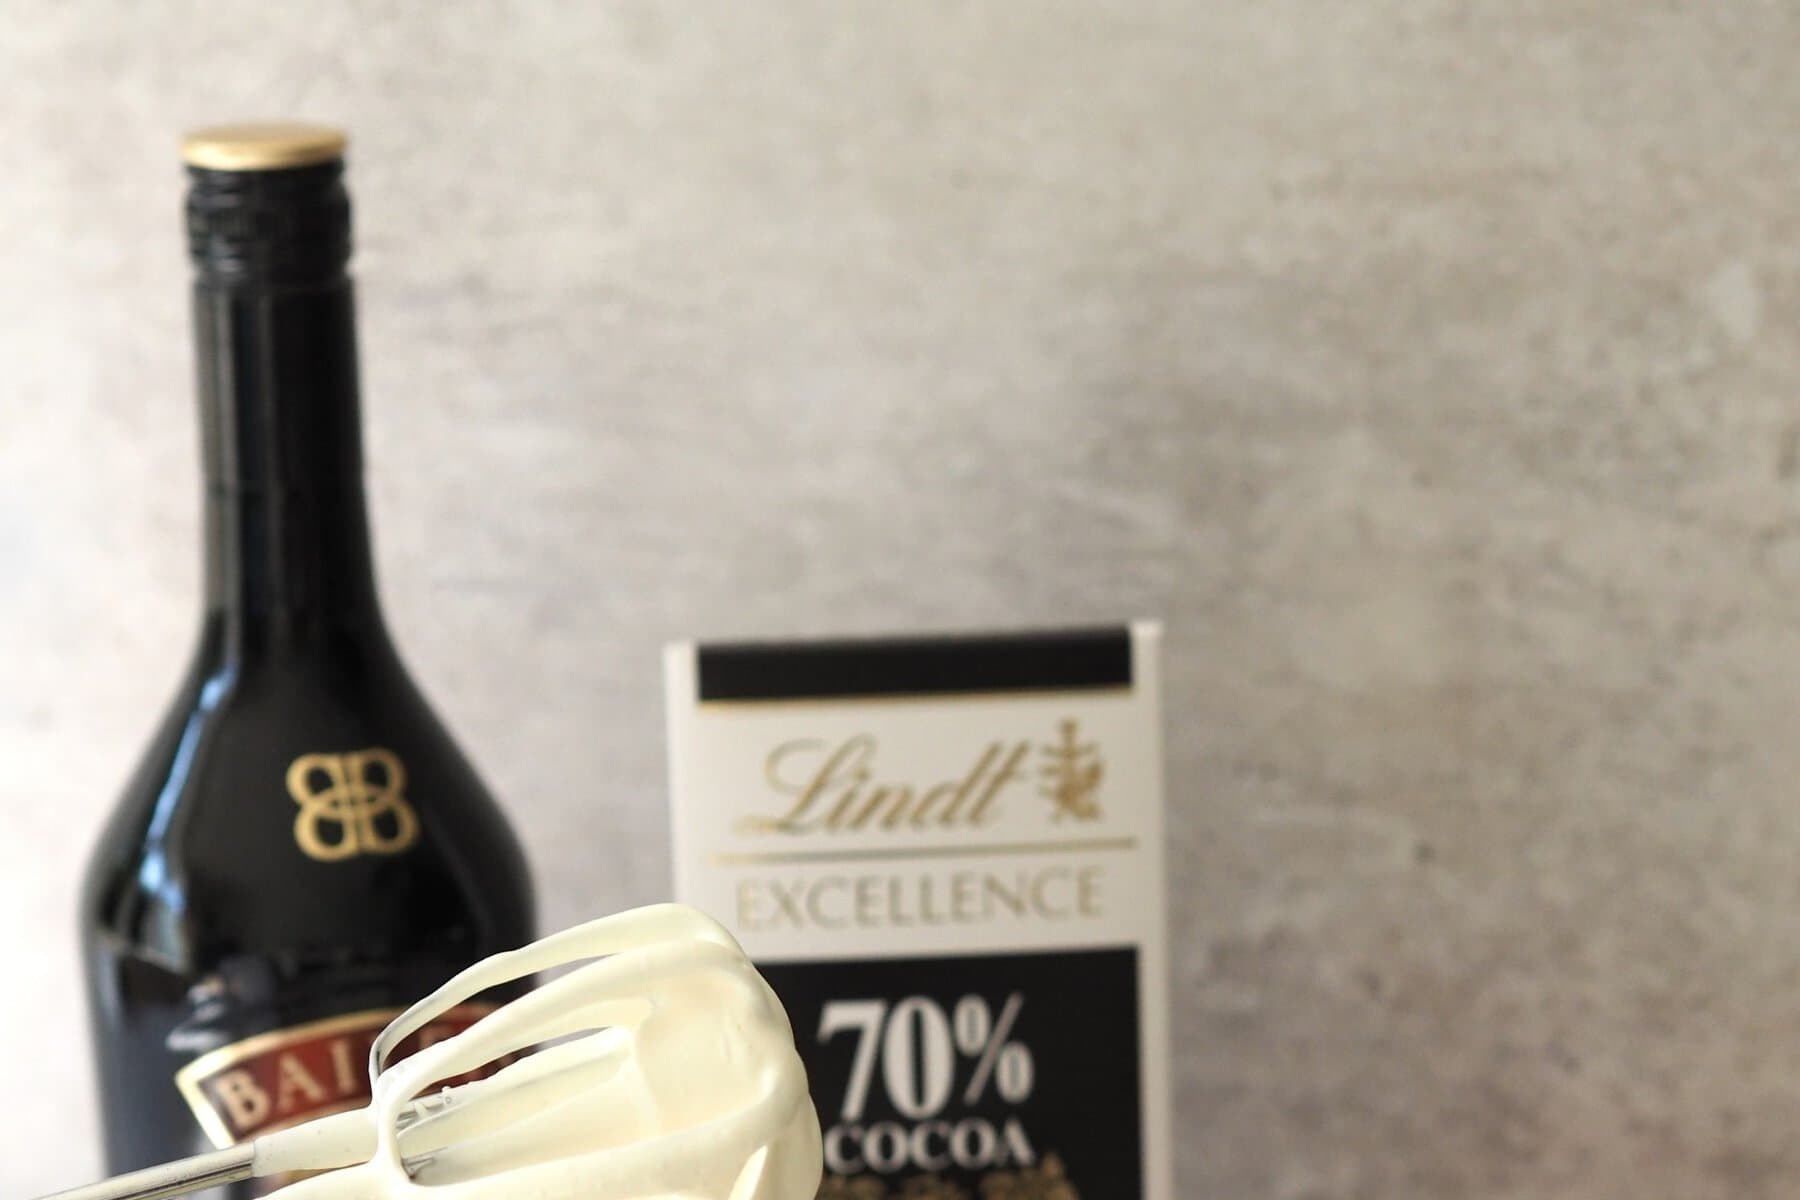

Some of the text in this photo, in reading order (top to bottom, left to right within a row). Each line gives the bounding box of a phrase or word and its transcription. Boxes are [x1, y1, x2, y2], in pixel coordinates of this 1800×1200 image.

[733, 733, 1029, 838] Lindt
[736, 865, 1105, 932] EXCELLENCE
[817, 991, 1035, 1122] 70%
[822, 1117, 1035, 1175] COCOA
